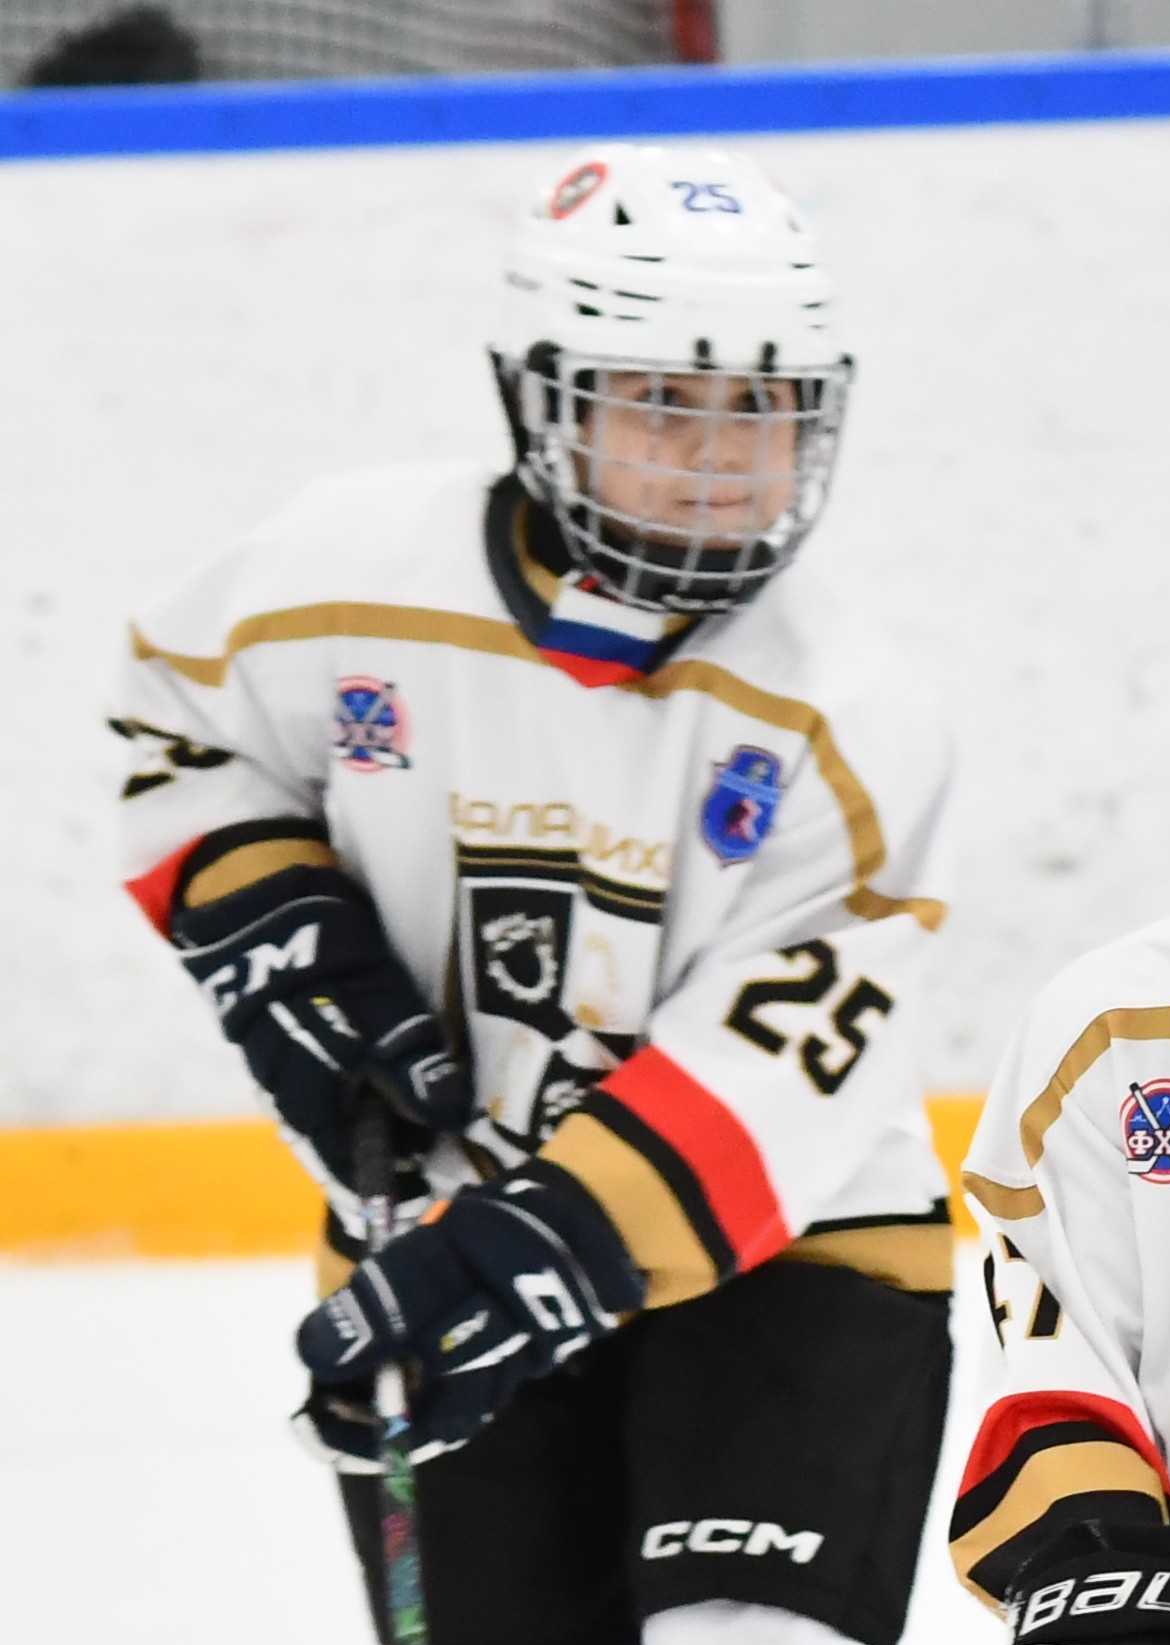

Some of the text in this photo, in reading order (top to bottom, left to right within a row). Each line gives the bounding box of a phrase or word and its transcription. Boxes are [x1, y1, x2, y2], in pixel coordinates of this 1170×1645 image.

[671, 180, 743, 214] 25
[725, 939, 895, 1098] 25
[641, 1518, 825, 1564] CCM
